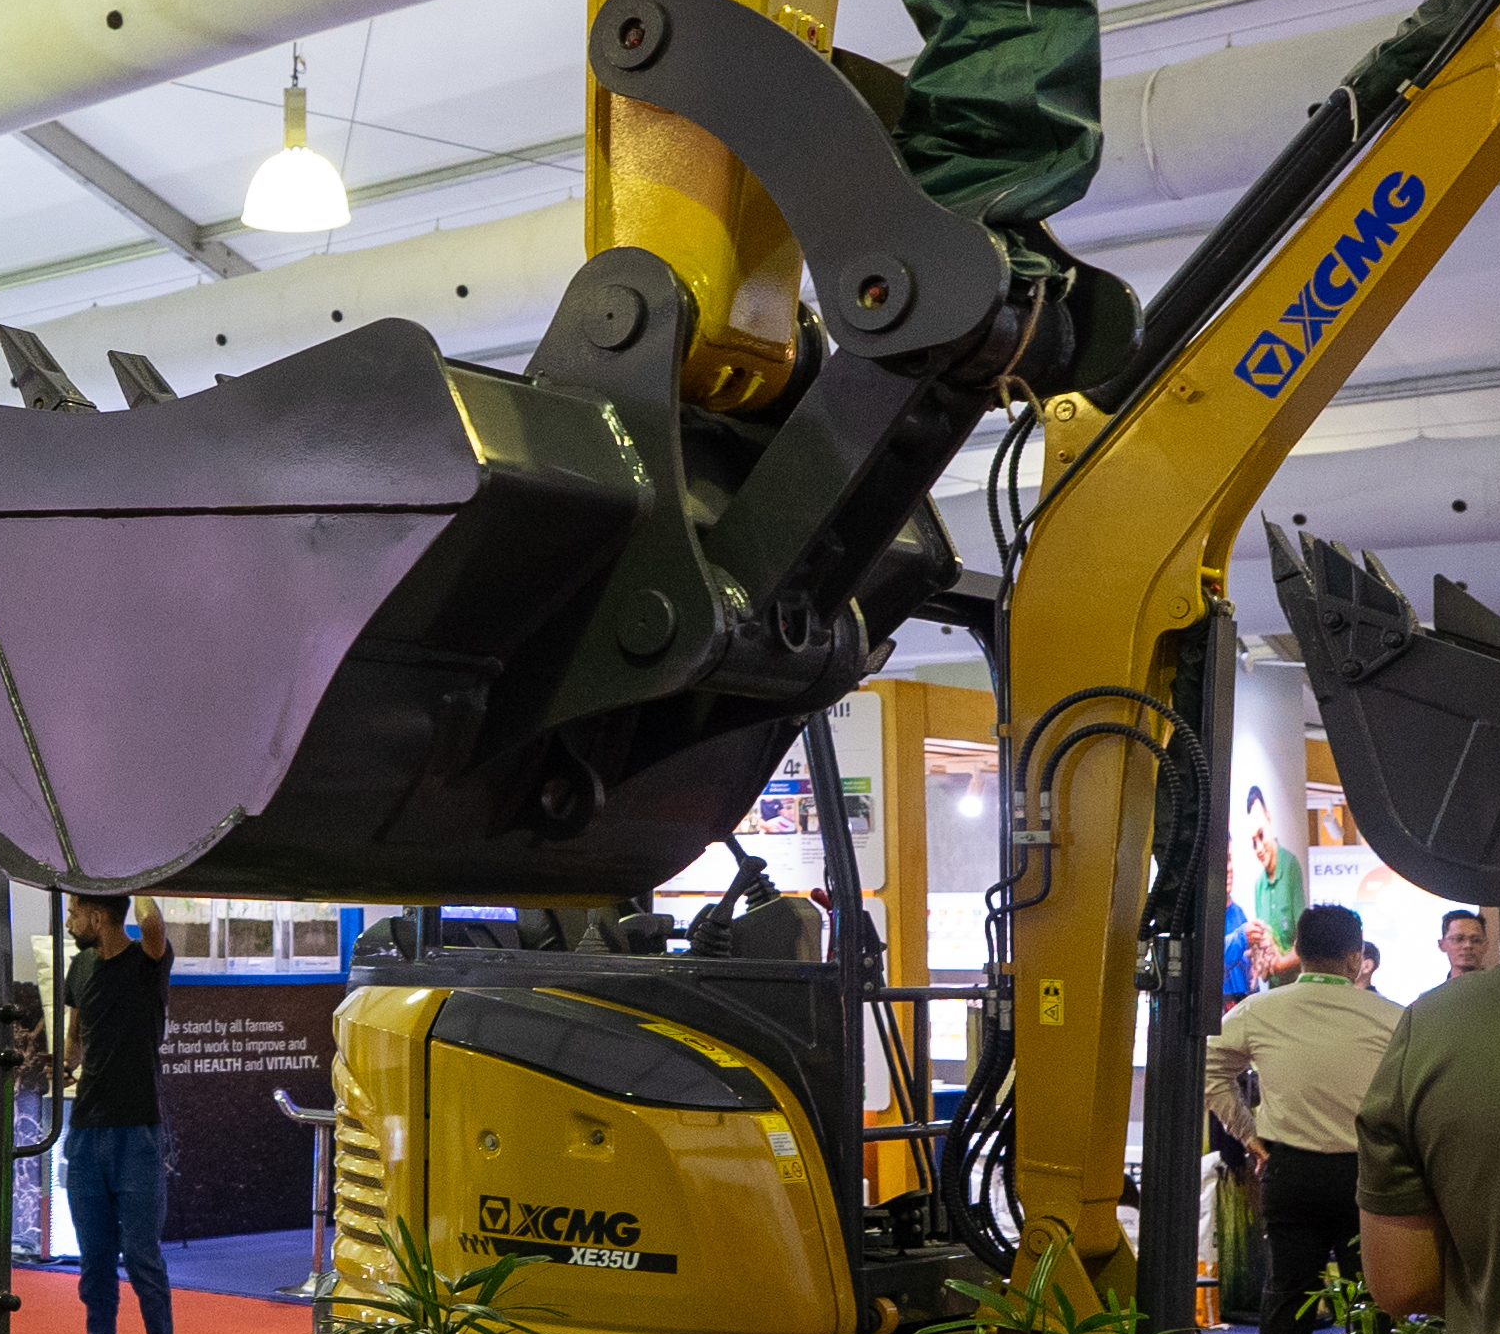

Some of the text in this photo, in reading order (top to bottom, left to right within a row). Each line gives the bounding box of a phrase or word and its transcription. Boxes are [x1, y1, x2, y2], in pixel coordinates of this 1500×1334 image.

[1279, 171, 1426, 355] XCMG
[1314, 864, 1359, 876] EASY!
[182, 1019, 212, 1034] stand
[214, 1019, 227, 1036] by
[229, 1018, 242, 1032] all
[245, 1018, 284, 1032] farmers
[159, 1037, 307, 1055] eir hard work to improve and
[173, 1059, 191, 1073] soil
[194, 1058, 241, 1073] HEALTH
[244, 1057, 263, 1071] and
[266, 1055, 319, 1070] VITALITY.
[511, 1203, 641, 1247] XCMG
[568, 1247, 640, 1270] XE35U
